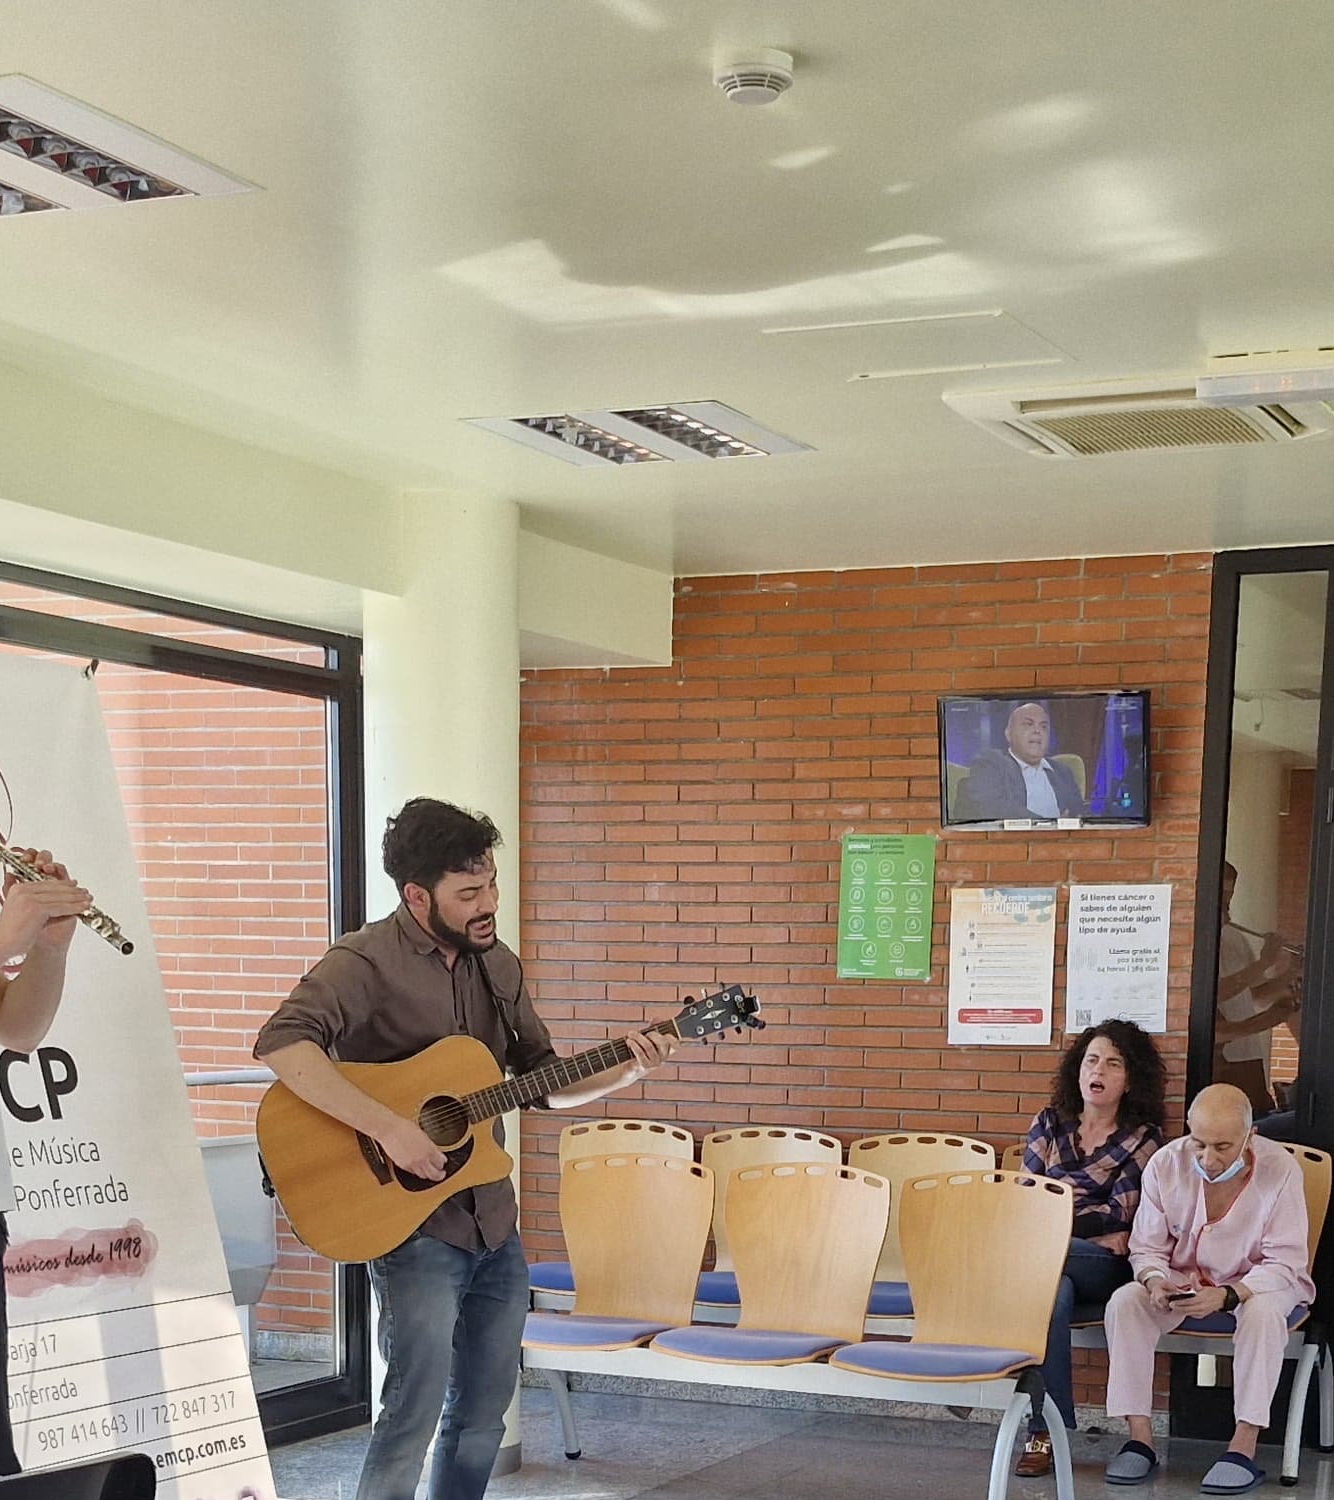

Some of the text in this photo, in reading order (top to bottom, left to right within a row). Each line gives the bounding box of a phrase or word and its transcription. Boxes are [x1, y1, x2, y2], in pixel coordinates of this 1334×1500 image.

[1098, 915, 1135, 923] necesite
[1106, 904, 1118, 912] de
[1119, 904, 1152, 913] alguien
[1110, 925, 1137, 935] ayuda
[11, 1136, 100, 1167] e Música
[14, 1174, 129, 1212] Ponferrada
[64, 1243, 104, 1268] desde
[109, 1236, 142, 1261] 1998
[8, 1333, 56, 1363] arja 17
[7, 1377, 78, 1410] onferrada
[38, 1427, 66, 1451] 987
[71, 1420, 98, 1443] 414
[101, 1414, 128, 1437] 643
[151, 1403, 179, 1425] 722
[182, 1396, 207, 1419] 847
[212, 1390, 236, 1413] 317
[155, 1434, 247, 1469] emcp.com.es
